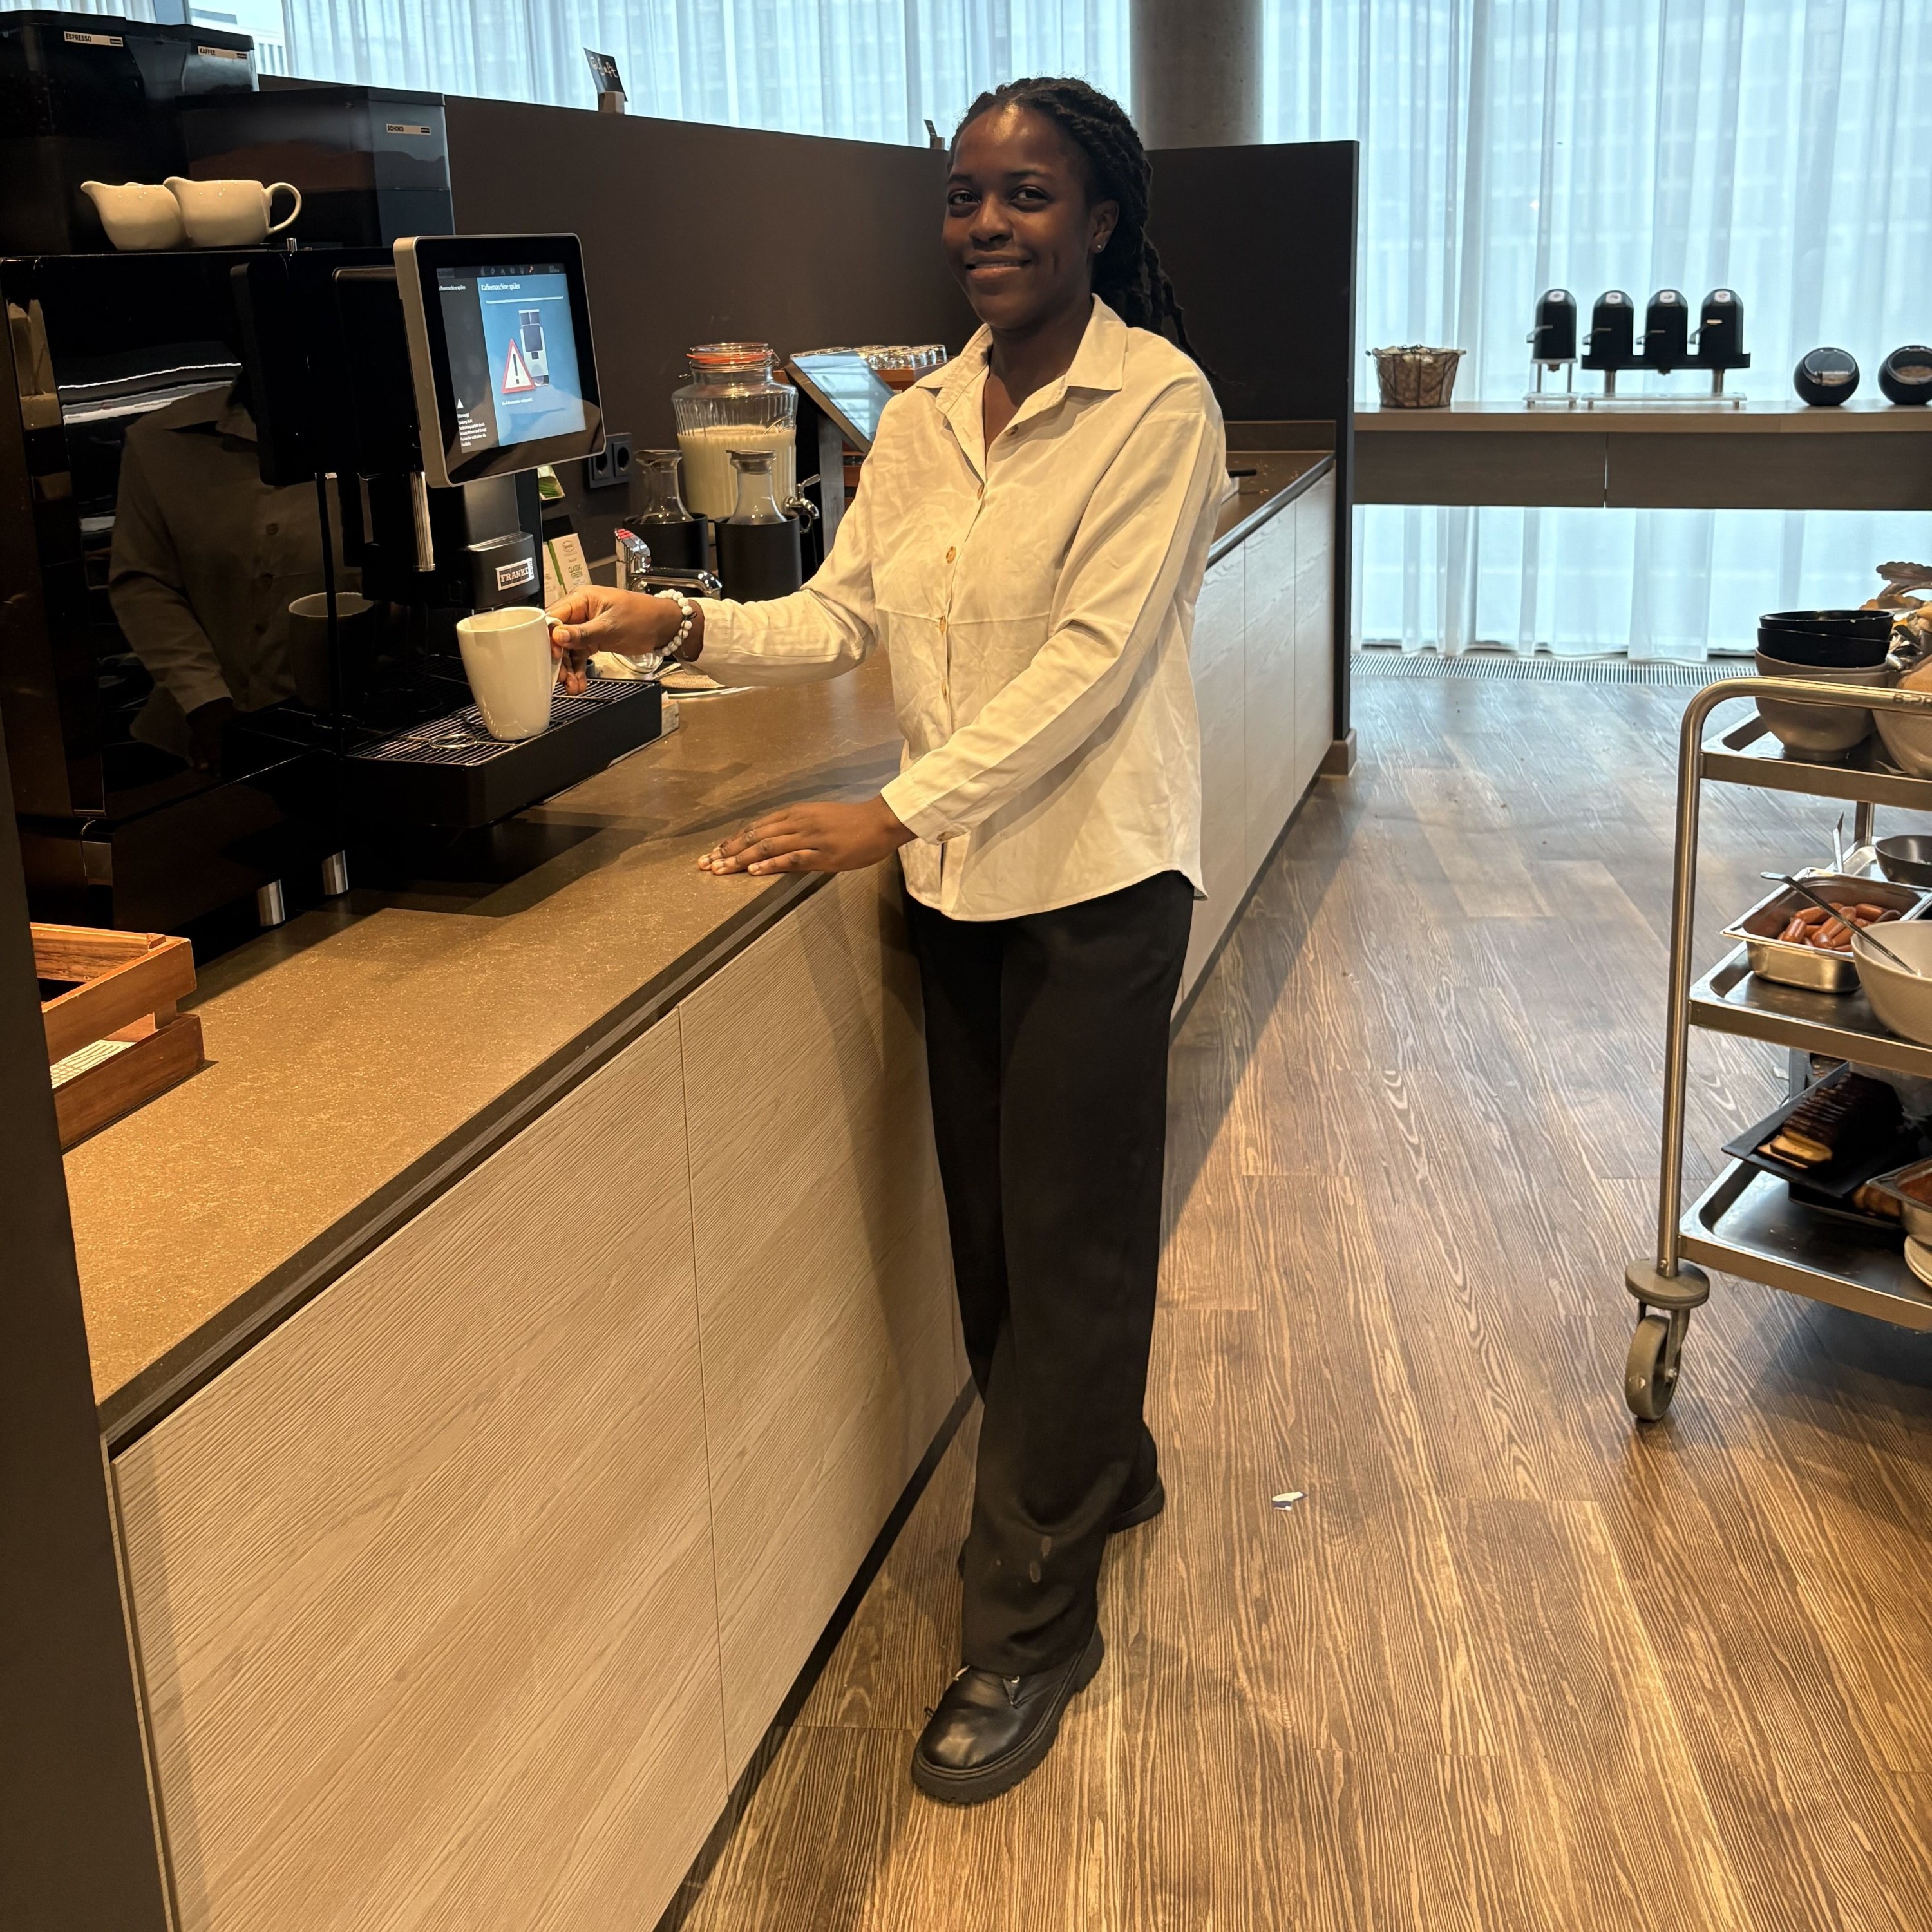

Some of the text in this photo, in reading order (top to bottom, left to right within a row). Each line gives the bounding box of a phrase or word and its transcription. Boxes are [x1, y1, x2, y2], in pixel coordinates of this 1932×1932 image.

[65, 33, 92, 43] ESPRESSO
[199, 47, 216, 56] KAFFEE
[387, 124, 404, 133] SCHOKO
[509, 282, 521, 291] spülen
